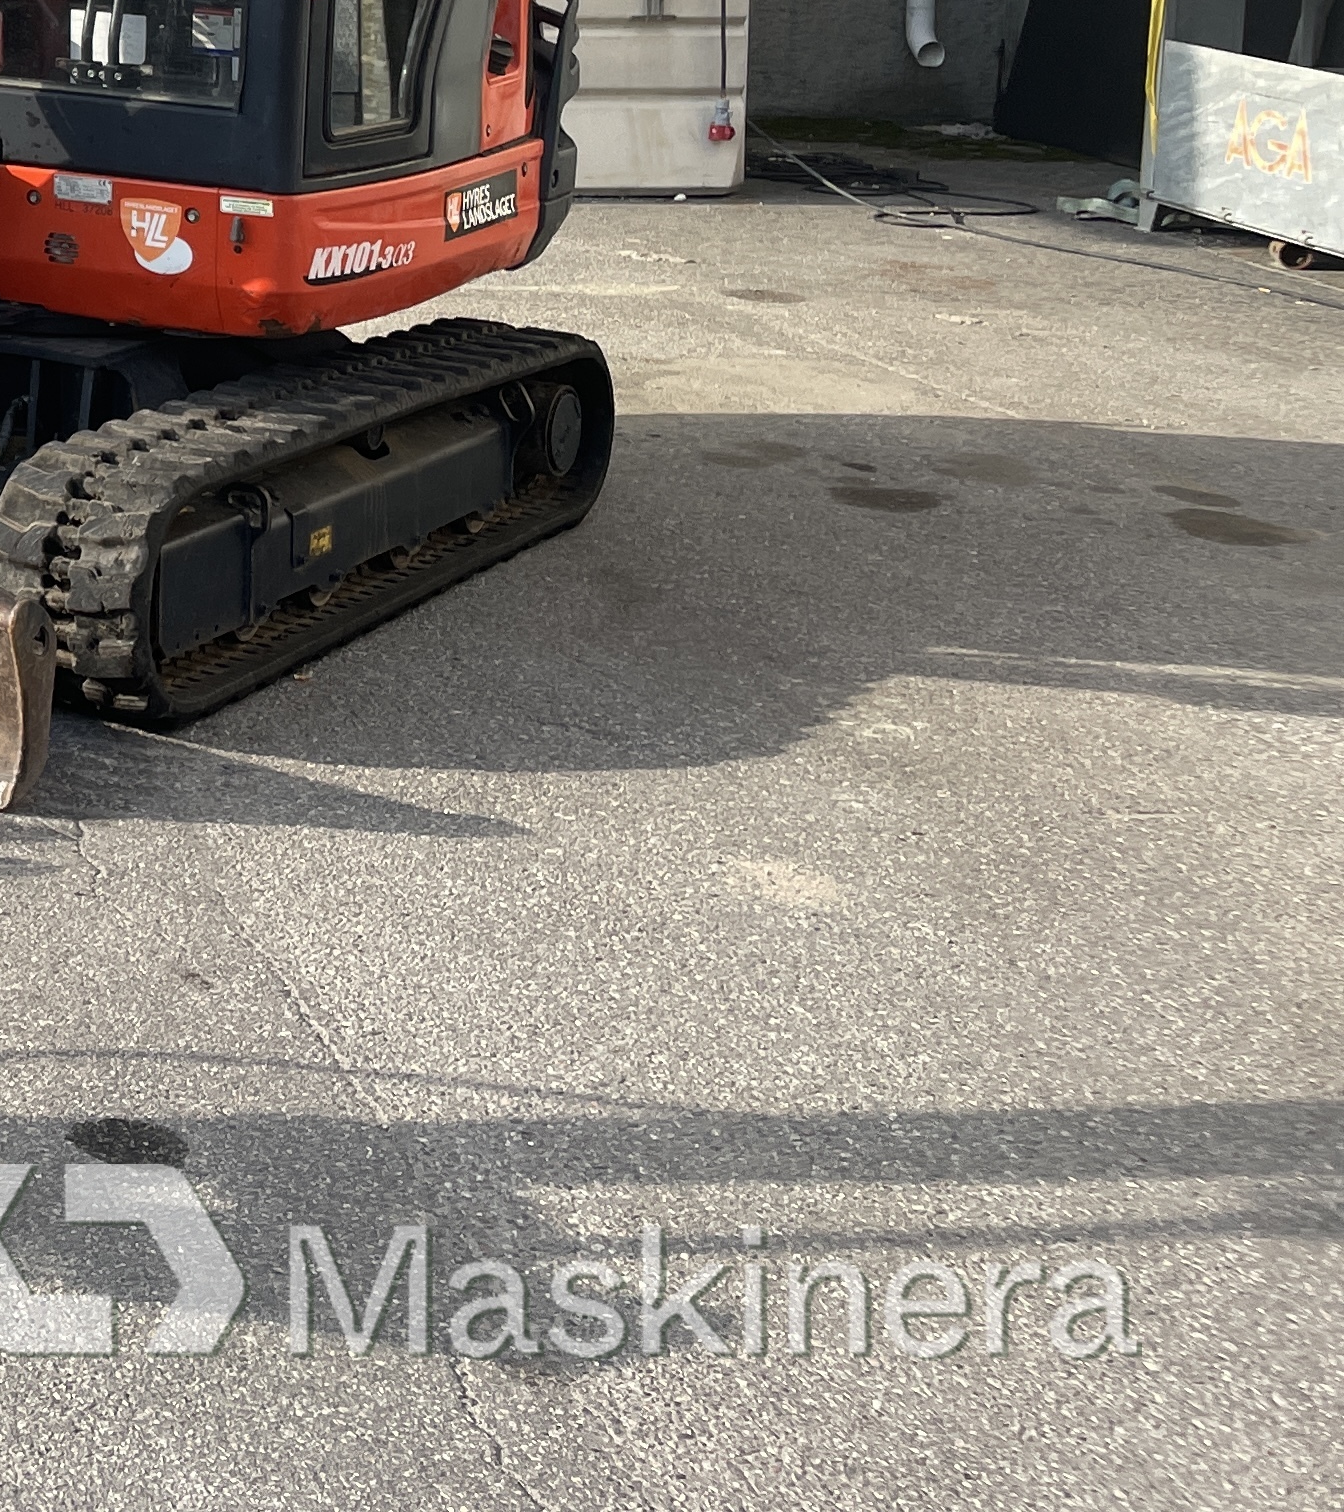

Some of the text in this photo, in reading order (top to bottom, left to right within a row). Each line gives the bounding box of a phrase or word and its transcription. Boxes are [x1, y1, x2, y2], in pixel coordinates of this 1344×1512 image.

[1224, 97, 1313, 184] AGA
[462, 184, 490, 210] HYRES
[462, 193, 516, 230] LANDSLAGET
[130, 210, 169, 249] HLL
